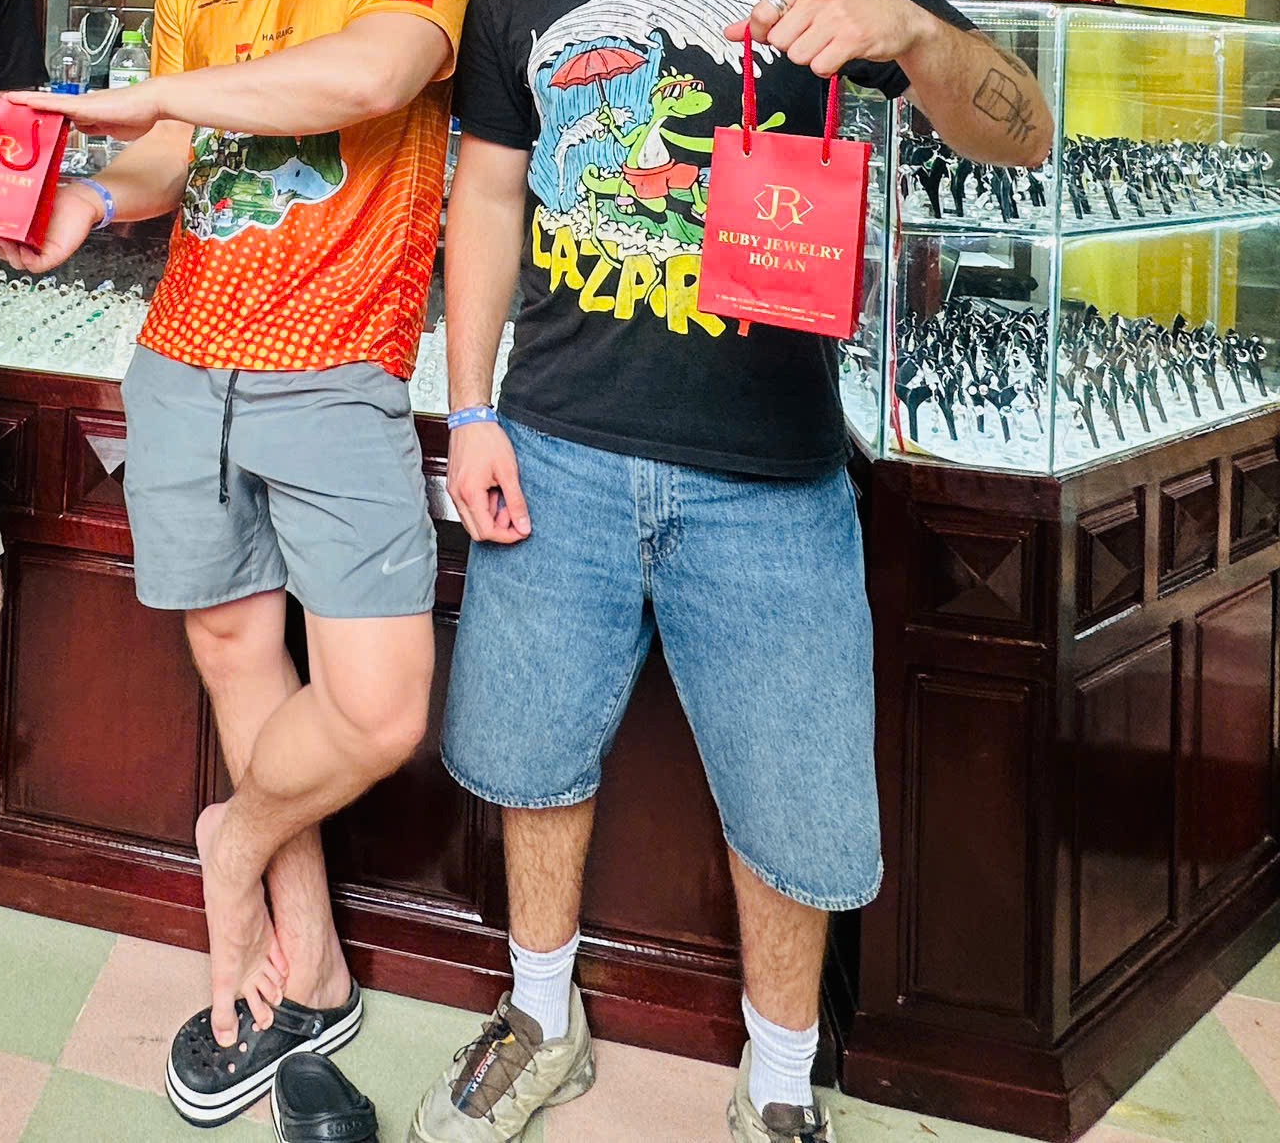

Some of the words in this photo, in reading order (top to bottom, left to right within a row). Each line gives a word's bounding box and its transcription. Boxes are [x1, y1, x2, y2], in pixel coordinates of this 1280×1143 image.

[718, 230, 761, 247] RUBY
[764, 237, 844, 261] JEWELRY
[749, 251, 779, 270] HỘI
[783, 258, 807, 272] AN
